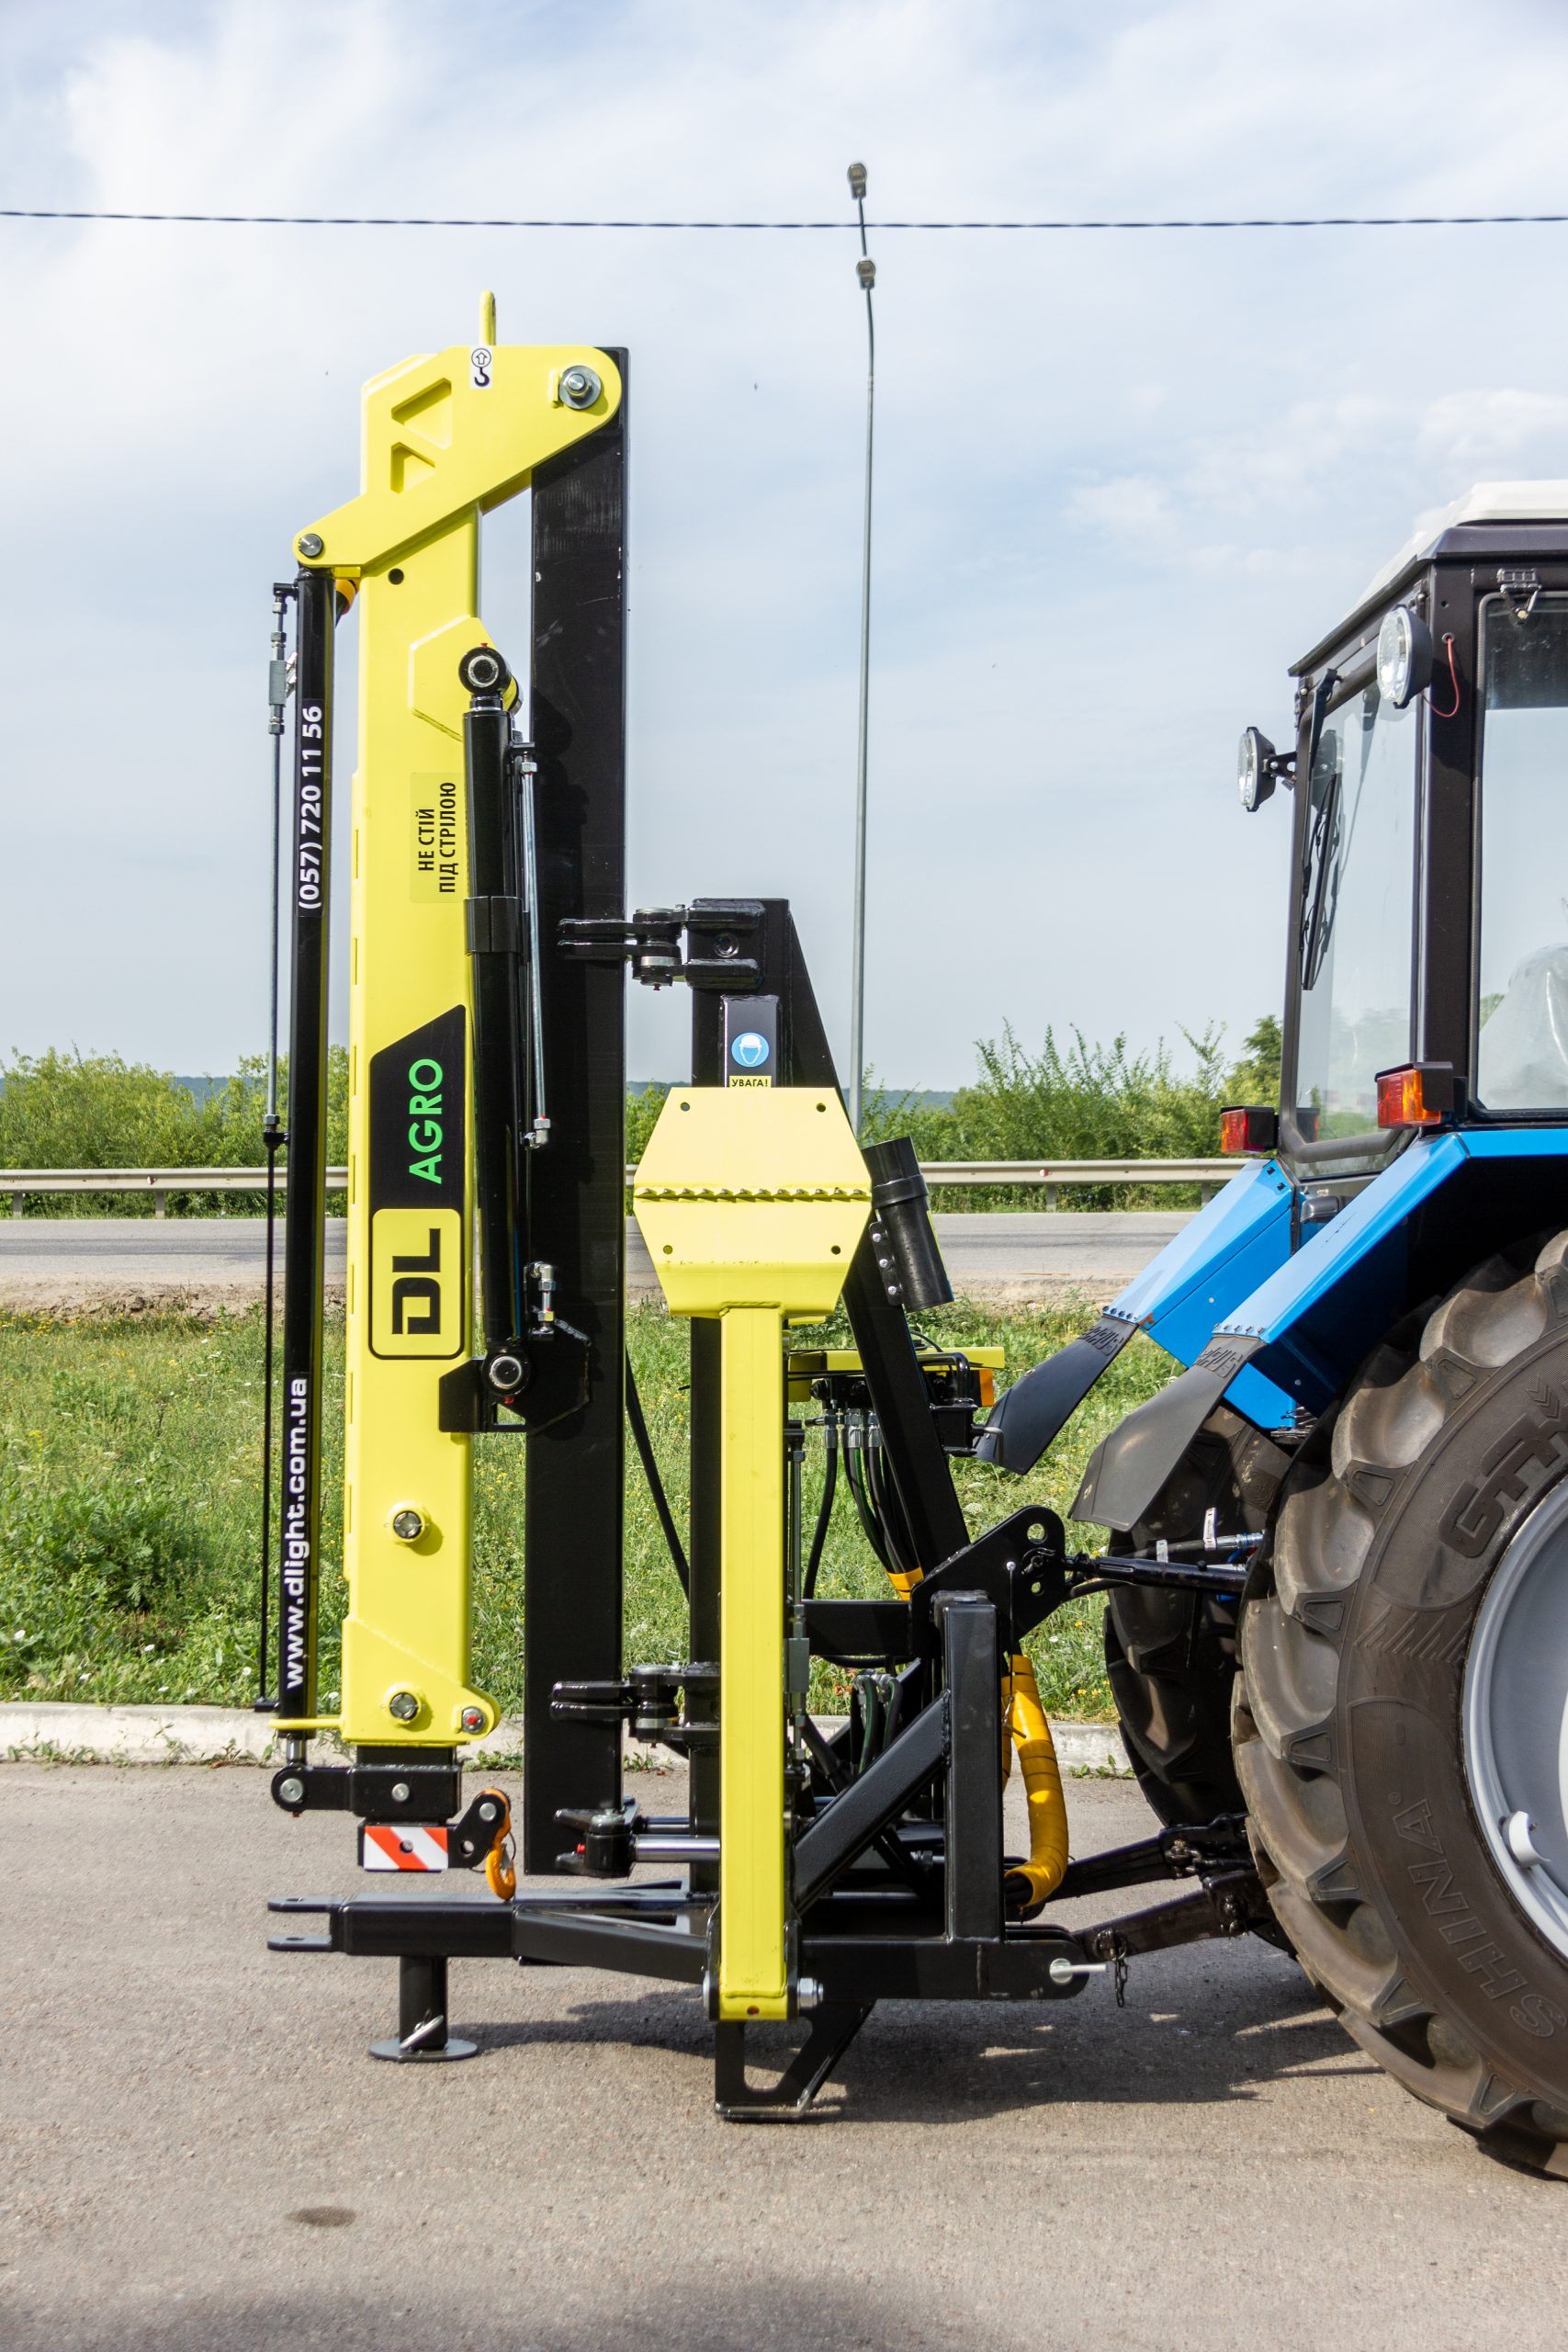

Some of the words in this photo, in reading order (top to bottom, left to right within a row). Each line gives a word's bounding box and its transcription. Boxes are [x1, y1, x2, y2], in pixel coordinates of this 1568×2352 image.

[301, 705, 323, 740] 56
[300, 749, 322, 777] 11
[299, 785, 322, 835] 720
[415, 808, 434, 846] СТІЙ
[438, 782, 457, 858] СТРІЛОЮ
[298, 842, 323, 910] (057)
[418, 851, 434, 871] НЕ
[438, 863, 458, 893] ПІД
[731, 1079, 768, 1087] УВАГА!
[408, 1058, 444, 1185] AGRO
[391, 1227, 441, 1335] DL
[284, 1377, 310, 1690] www.dlight.com.ua
